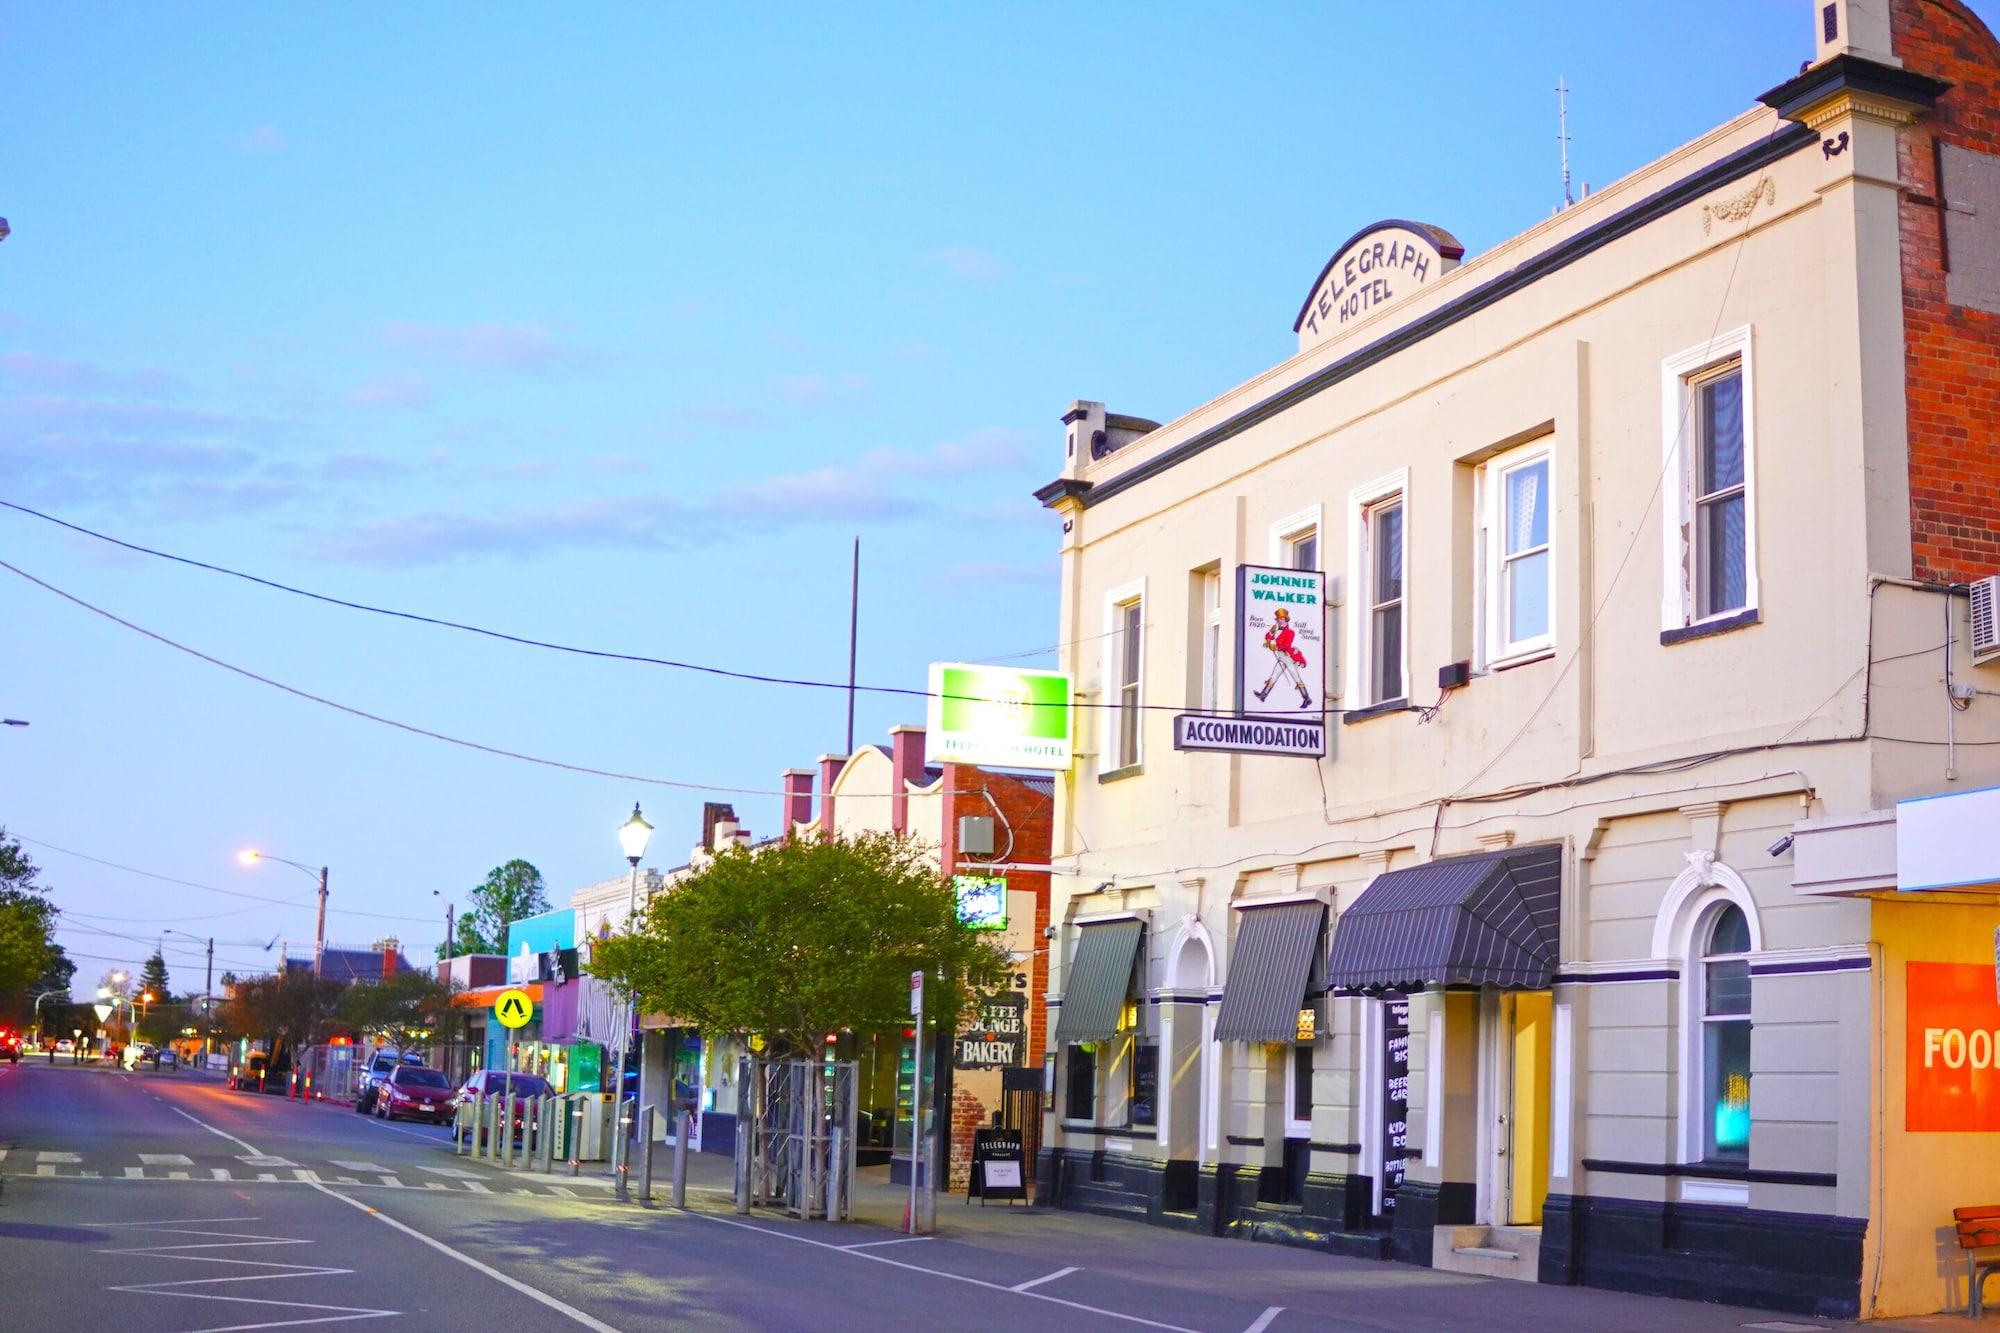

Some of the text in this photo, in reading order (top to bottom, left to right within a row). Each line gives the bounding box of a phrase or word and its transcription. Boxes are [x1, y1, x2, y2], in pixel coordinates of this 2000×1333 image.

[1306, 240, 1430, 335] TELEGRAPH
[1340, 279, 1393, 323] HOTEL
[1252, 573, 1316, 589] JOHNNIE
[1252, 589, 1317, 604] WALKER
[1186, 721, 1319, 748] ACCOMMODATION
[969, 1017, 1020, 1033] OUNGE
[963, 1041, 1016, 1063] BAKERY
[1394, 1049, 1408, 1062] BIS
[1924, 1027, 2000, 1069] FOO
[1391, 1089, 1408, 1101] GAR
[980, 1141, 1021, 1150] TELEGRAPH
[1392, 1135, 1406, 1147] RO
